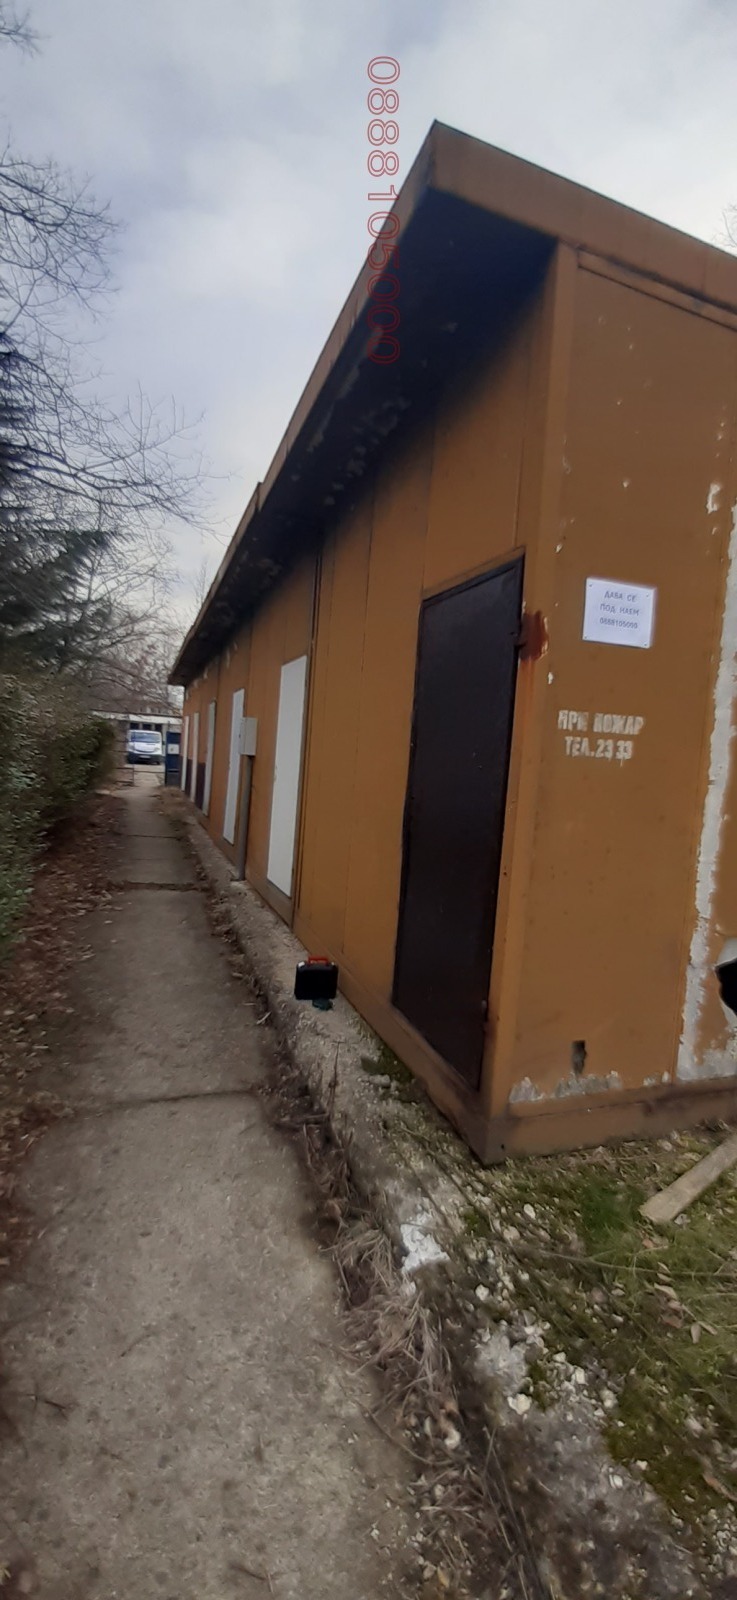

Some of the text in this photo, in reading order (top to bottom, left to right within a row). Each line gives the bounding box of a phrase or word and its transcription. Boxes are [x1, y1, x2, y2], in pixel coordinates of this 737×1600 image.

[604, 590, 637, 602] ДАВА СЕ
[600, 603, 640, 616] ПОД НАЕМ
[593, 712, 644, 736] ПОЖАР
